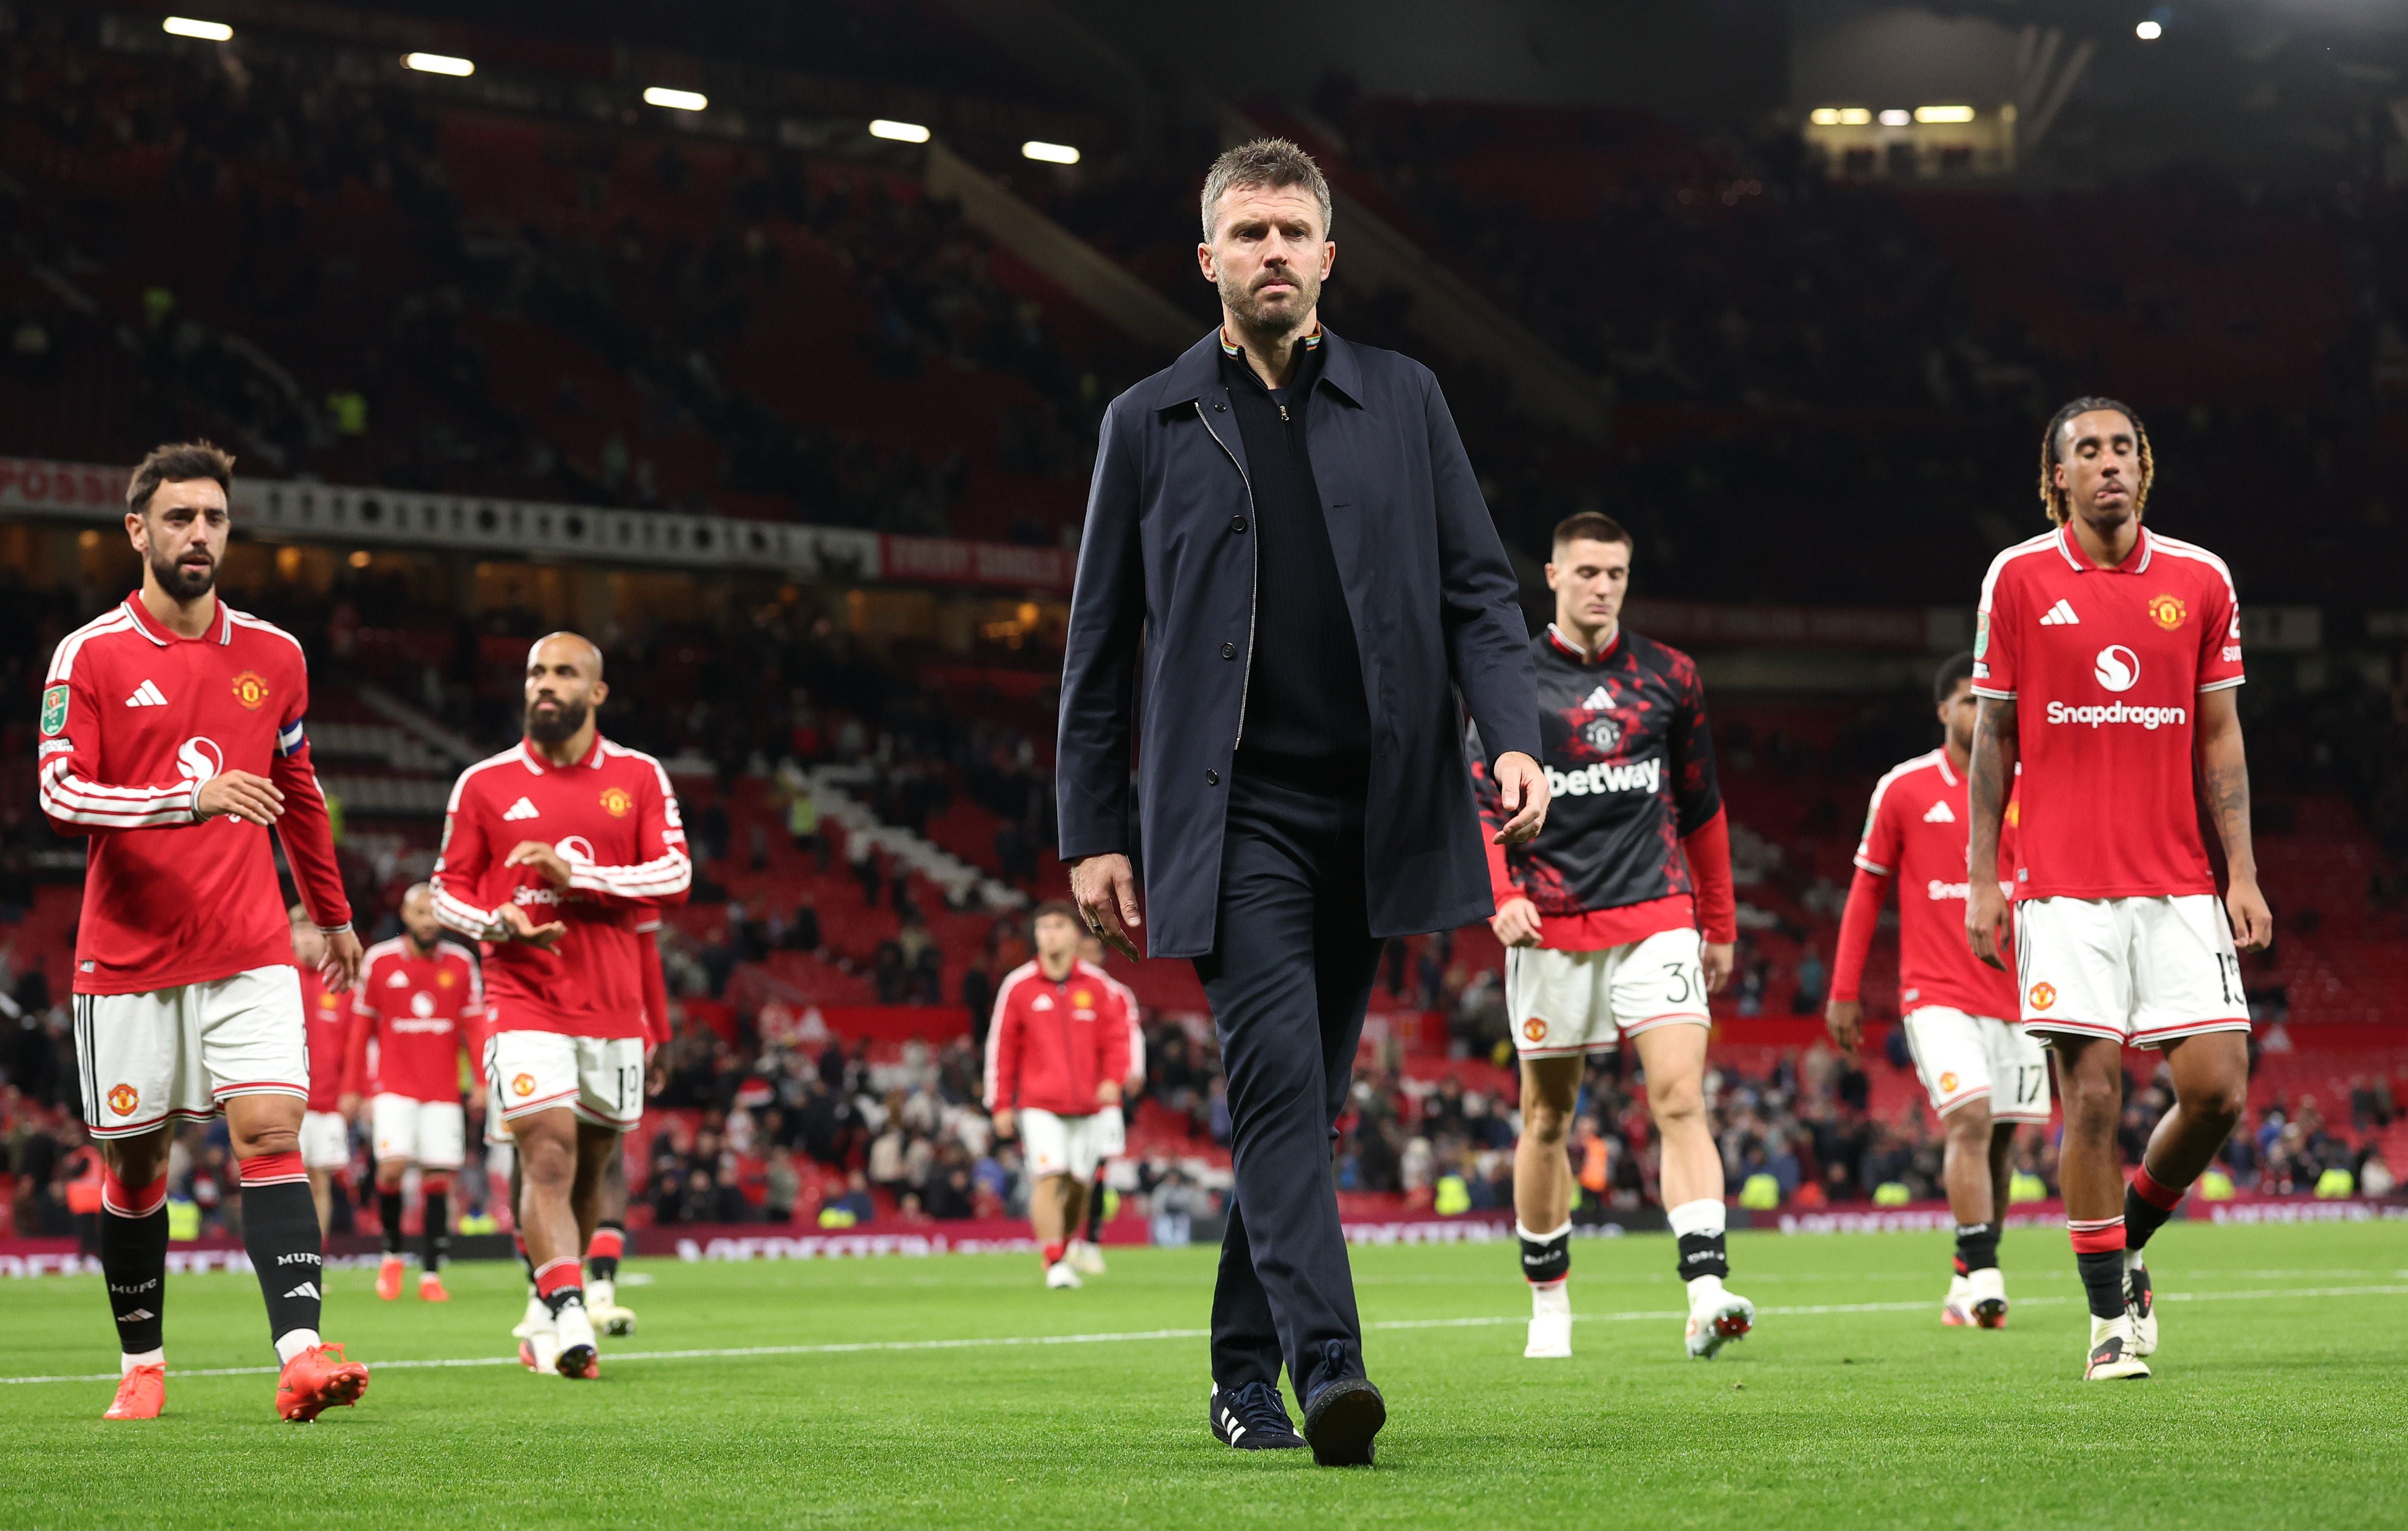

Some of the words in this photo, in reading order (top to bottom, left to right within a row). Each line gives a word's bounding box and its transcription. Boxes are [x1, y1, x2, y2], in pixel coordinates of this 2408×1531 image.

[2046, 700, 2186, 730] Snapdragon
[1543, 757, 1661, 798] betway
[617, 1065, 639, 1112] 19
[2017, 1064, 2043, 1105] 17
[276, 1252, 322, 1266] MUFC
[111, 1278, 157, 1294] MUFC
